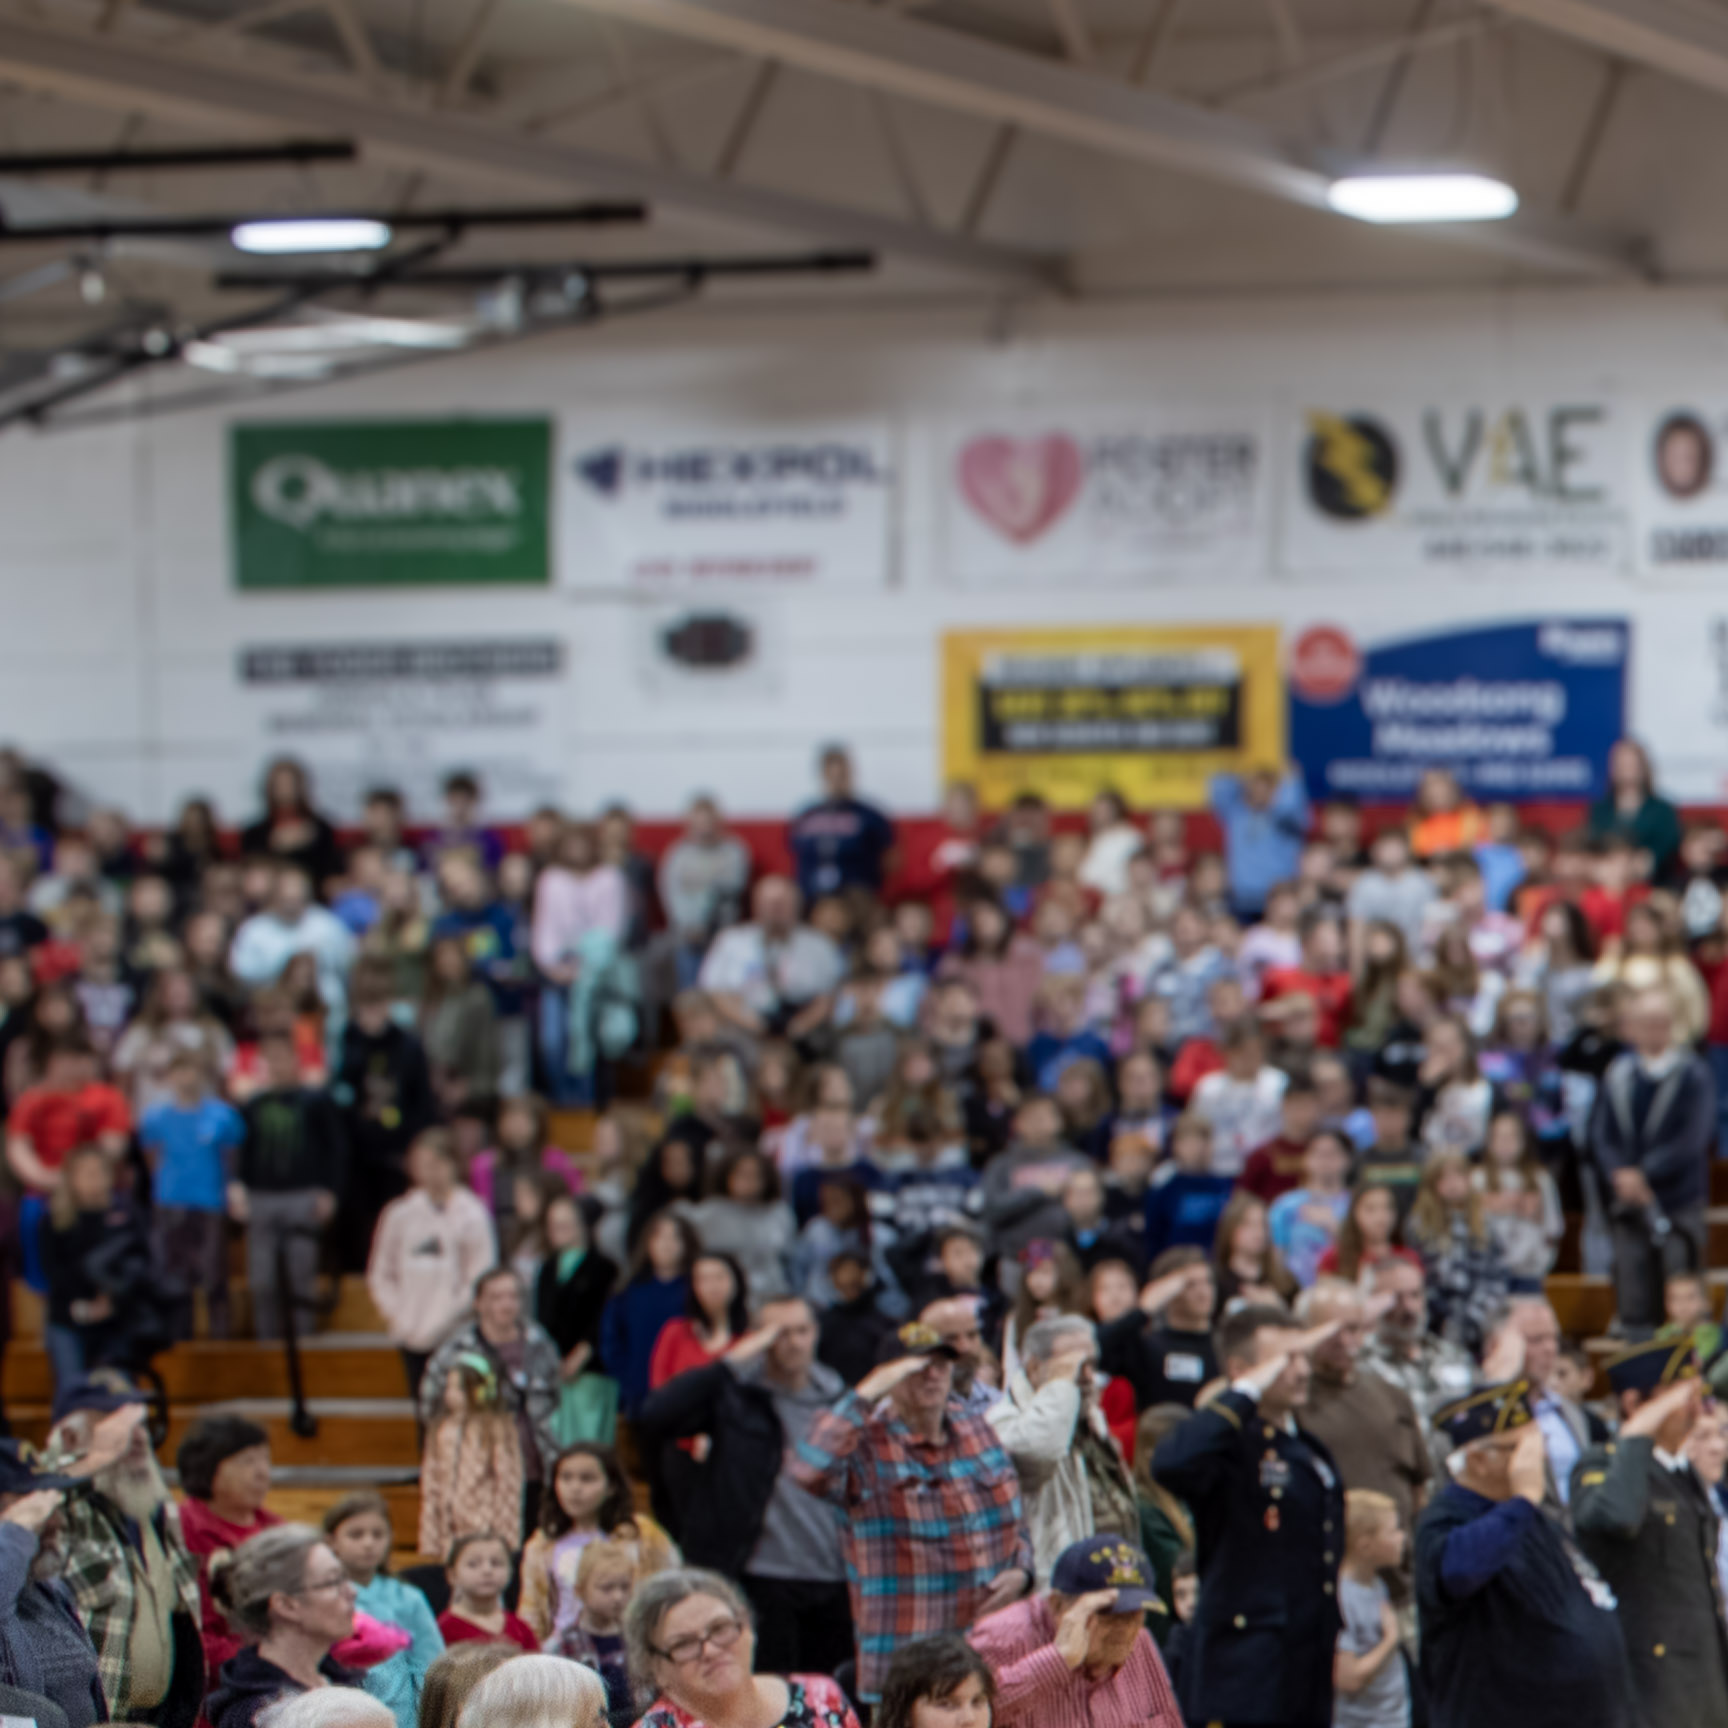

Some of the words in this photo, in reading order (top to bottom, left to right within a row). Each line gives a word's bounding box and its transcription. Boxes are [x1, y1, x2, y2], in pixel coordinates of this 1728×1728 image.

[634, 445, 889, 489] HEXPOL
[1424, 406, 1607, 501] VAE
[253, 452, 522, 529] Quanex
[1366, 682, 1560, 721] Woodsong
